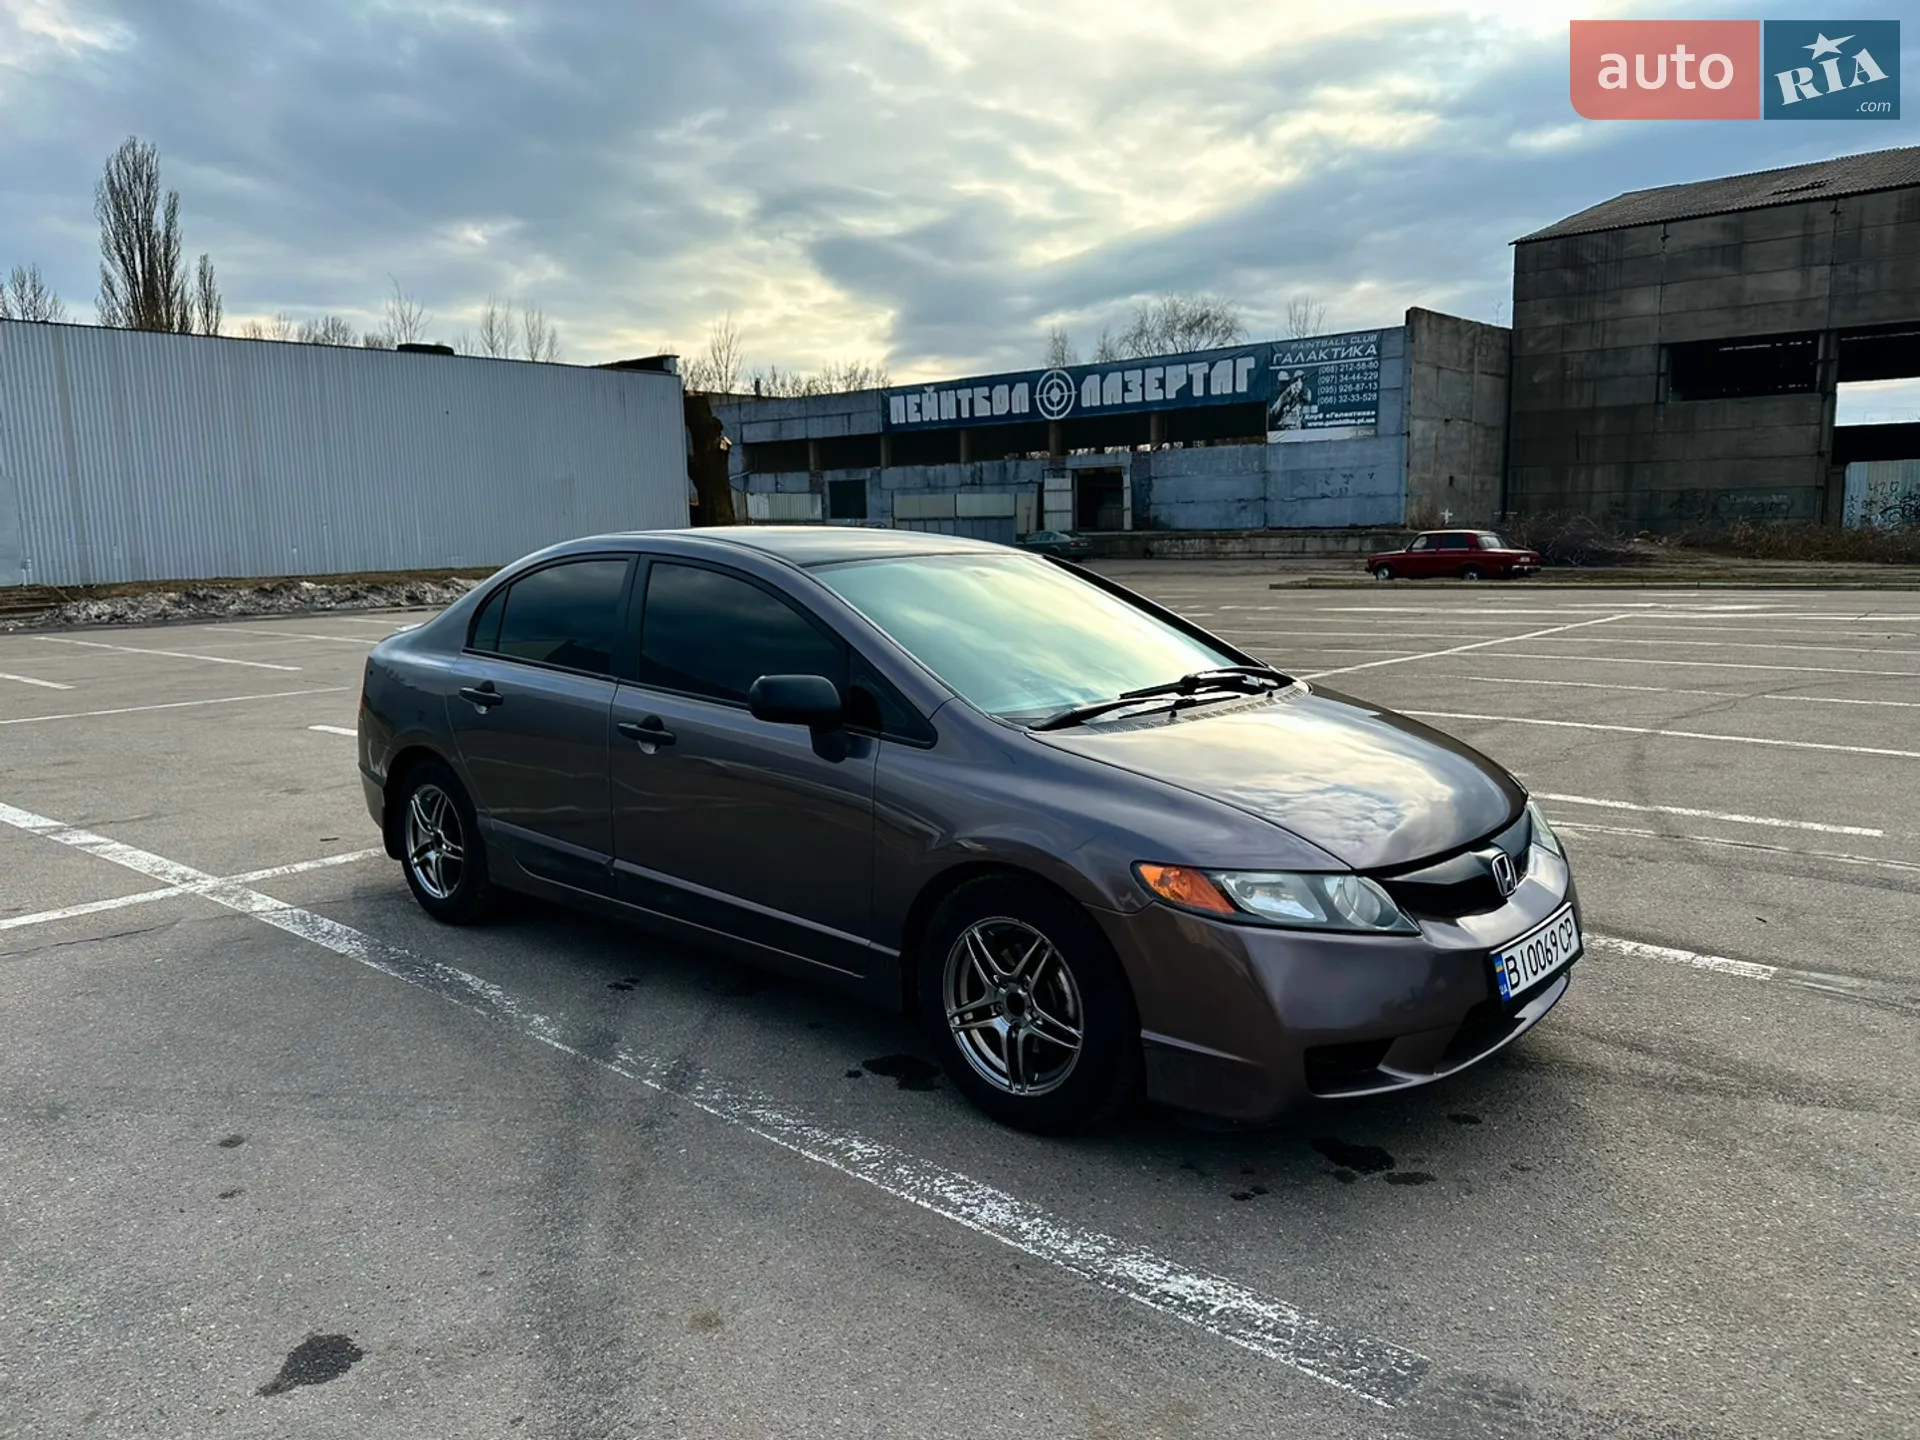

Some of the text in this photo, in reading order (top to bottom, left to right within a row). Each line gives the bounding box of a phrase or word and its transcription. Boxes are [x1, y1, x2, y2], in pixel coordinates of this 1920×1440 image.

[1290, 334, 1378, 350] PAINTBALL CLUB
[1272, 344, 1378, 365] ГАЛАКТИКА
[1317, 372, 1379, 385] (097) 34-44-229
[889, 356, 1256, 424] ПЕЙНТБОЛ ЛАЗЕРТАГ
[1338, 393, 1377, 403] 32-33-528
[1304, 412, 1324, 420] Клуб
